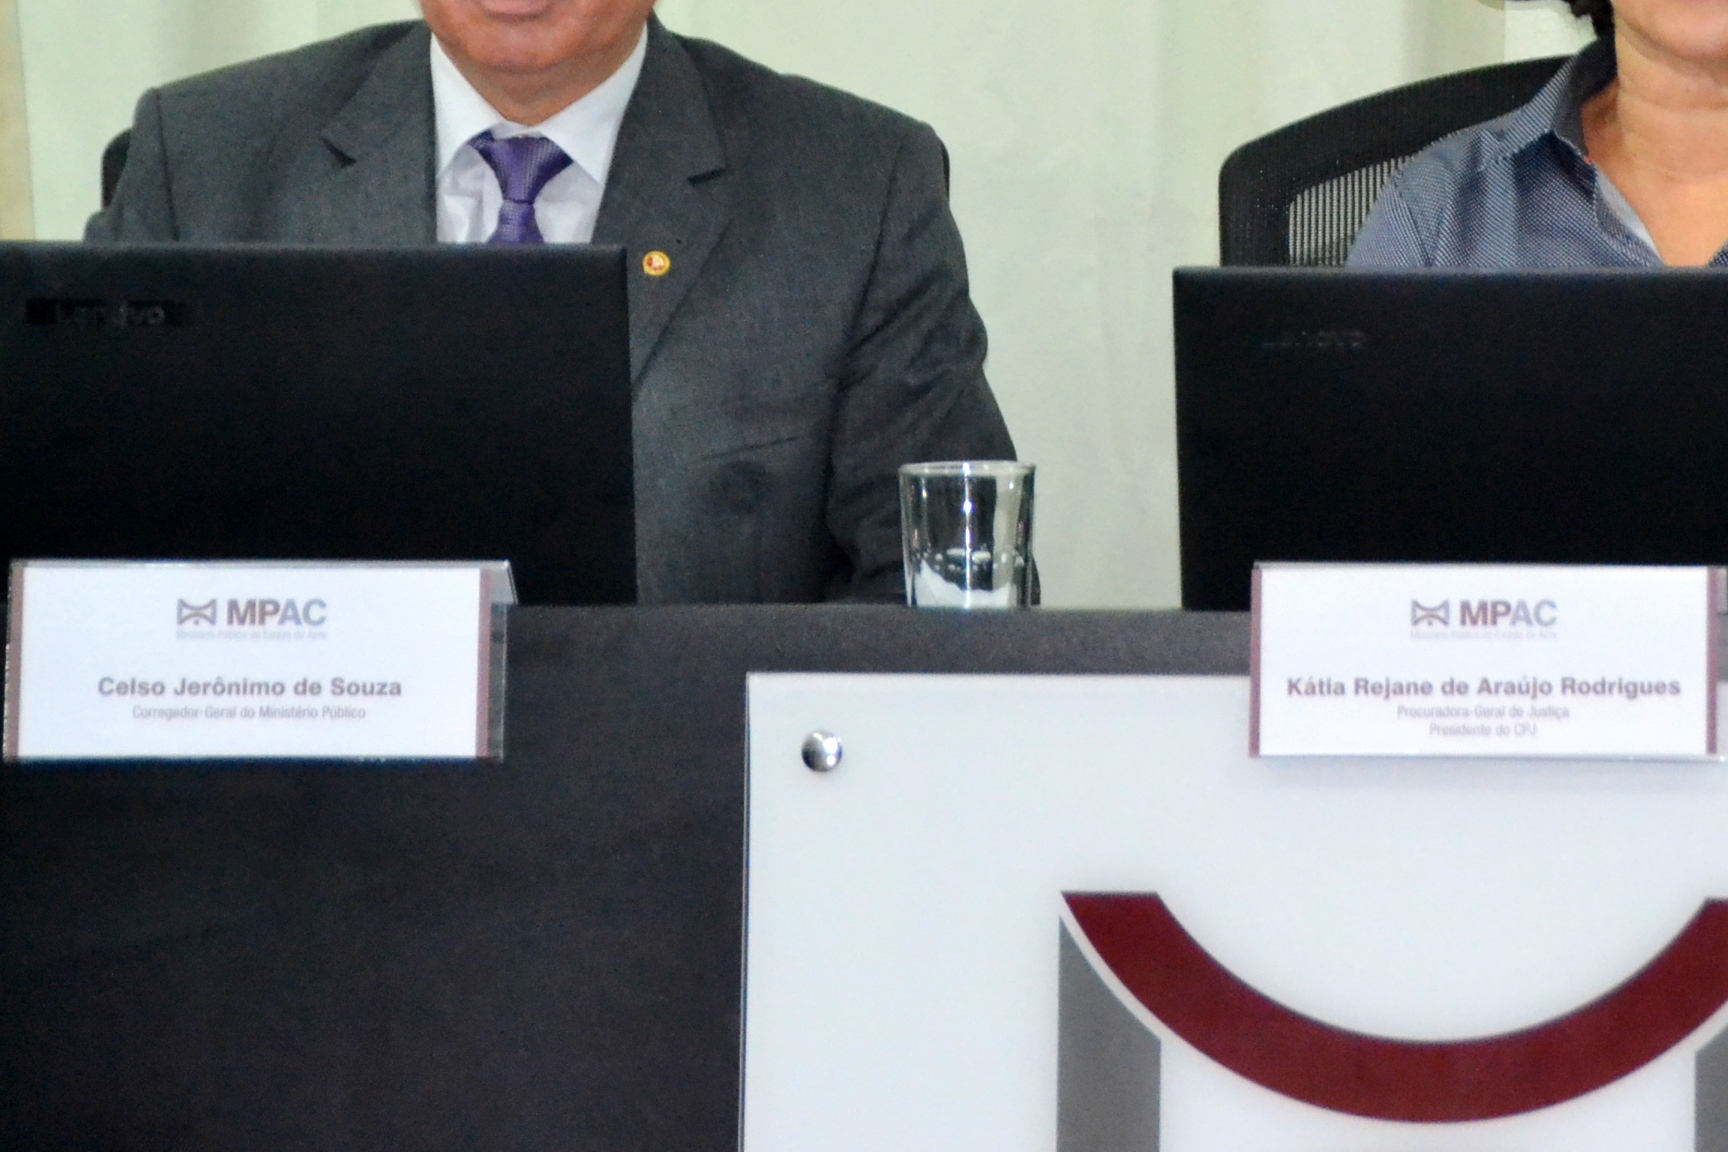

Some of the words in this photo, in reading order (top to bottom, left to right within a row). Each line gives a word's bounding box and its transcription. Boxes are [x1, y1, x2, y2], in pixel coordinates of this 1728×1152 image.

[227, 598, 327, 626] MPAC
[1460, 599, 1557, 626] MPAC
[98, 676, 165, 697] Celso
[173, 675, 285, 697] Jerônimo
[293, 676, 322, 697] de
[330, 676, 402, 697] Souza
[1287, 676, 1345, 696] Kátia
[1354, 676, 1433, 702] Rejane
[1441, 676, 1469, 696] de
[1477, 674, 1553, 699] Araújo
[1561, 676, 1681, 699] Rodrigues
[132, 704, 236, 721] Corregedor-Geral
[240, 705, 255, 719] do
[259, 704, 318, 719] Ministério
[322, 705, 366, 719] Público
[1509, 705, 1524, 718] de
